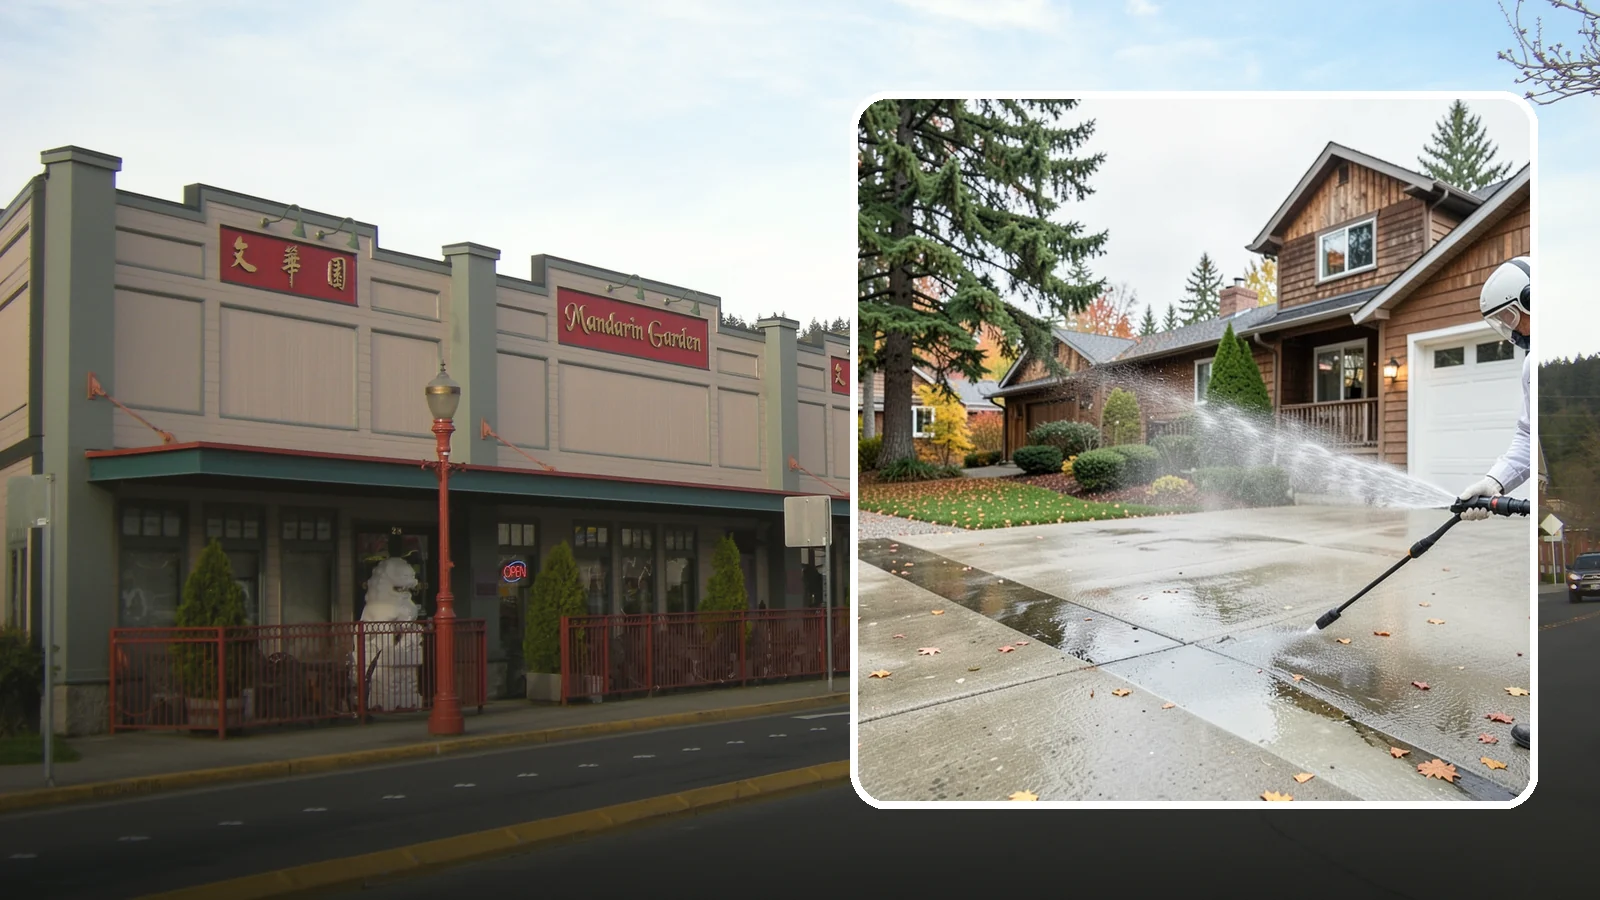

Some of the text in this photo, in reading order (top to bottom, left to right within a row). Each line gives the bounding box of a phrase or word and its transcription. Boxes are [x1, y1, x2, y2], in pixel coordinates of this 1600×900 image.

[231, 235, 346, 291] 文華園
[565, 302, 701, 352] Mandarin Garden
[503, 565, 527, 578] OPEN
